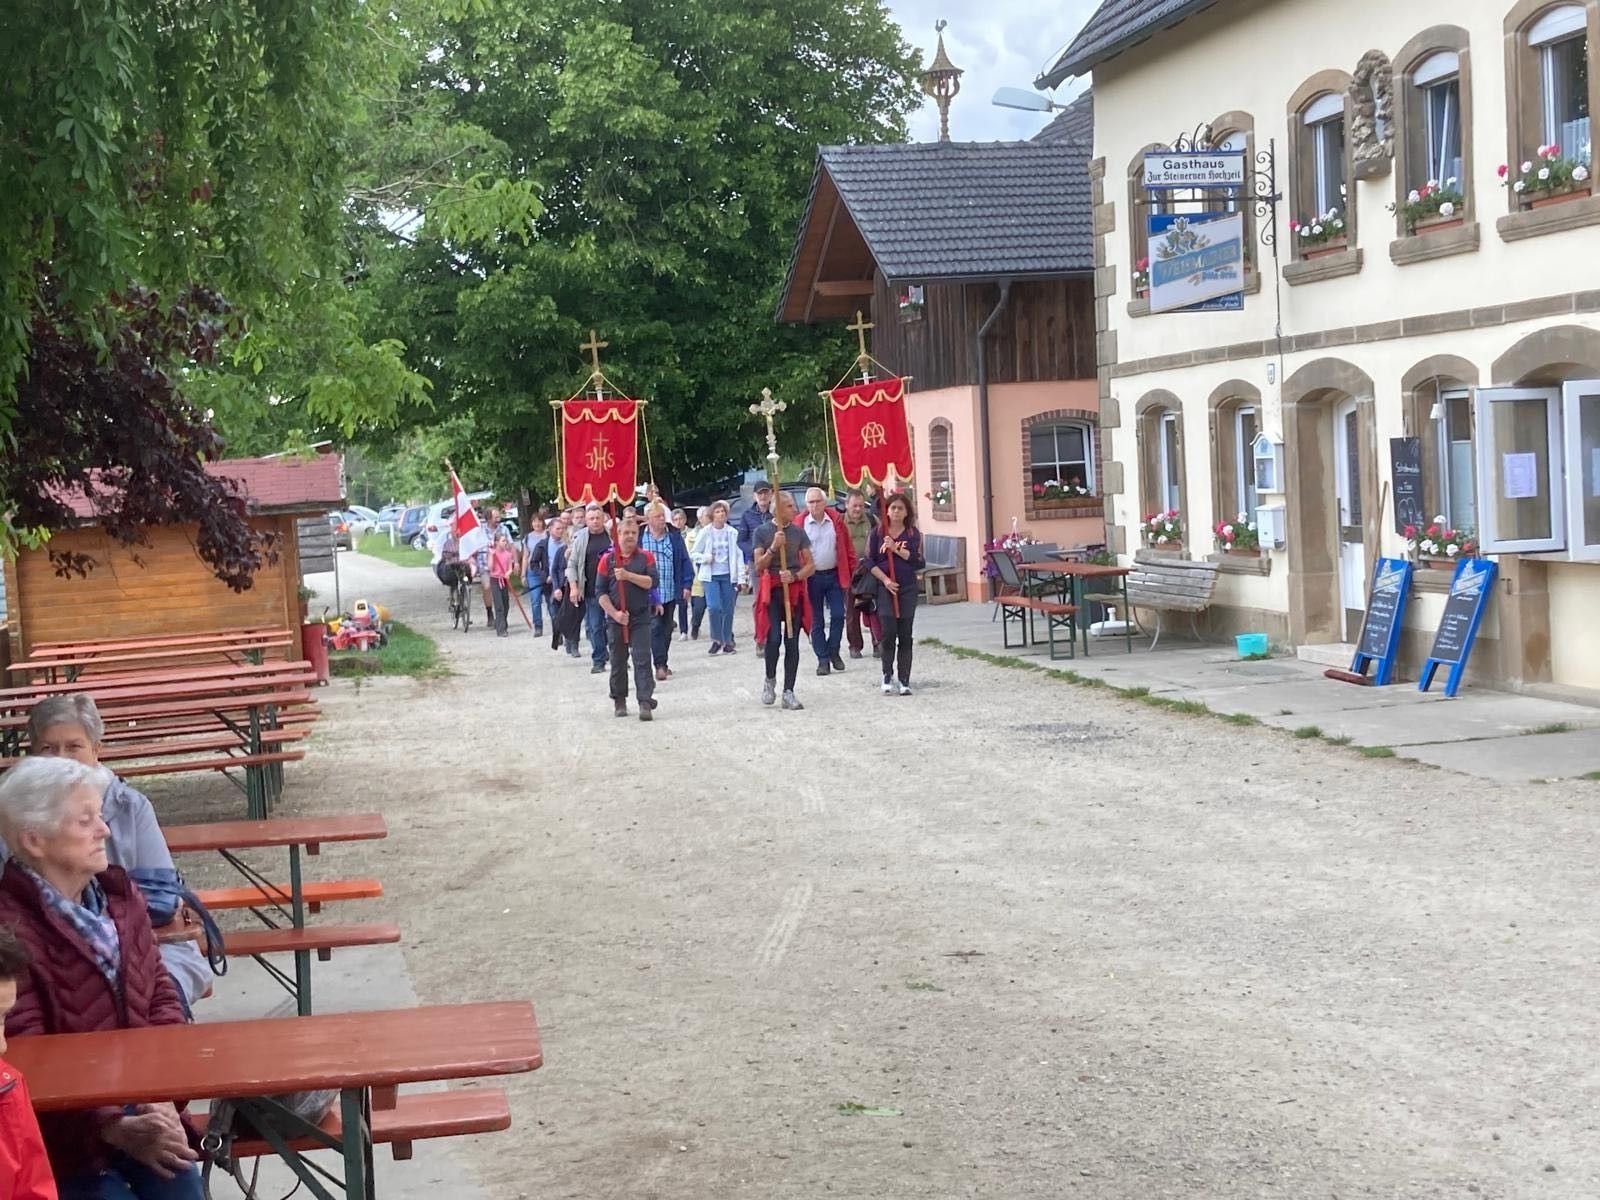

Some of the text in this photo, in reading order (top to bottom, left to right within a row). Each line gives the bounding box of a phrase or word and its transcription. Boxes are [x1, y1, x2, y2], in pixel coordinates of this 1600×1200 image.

[1163, 159, 1225, 170] Gasthaus
[1147, 170, 1162, 183] Zur
[1208, 170, 1241, 181] Hochzeit
